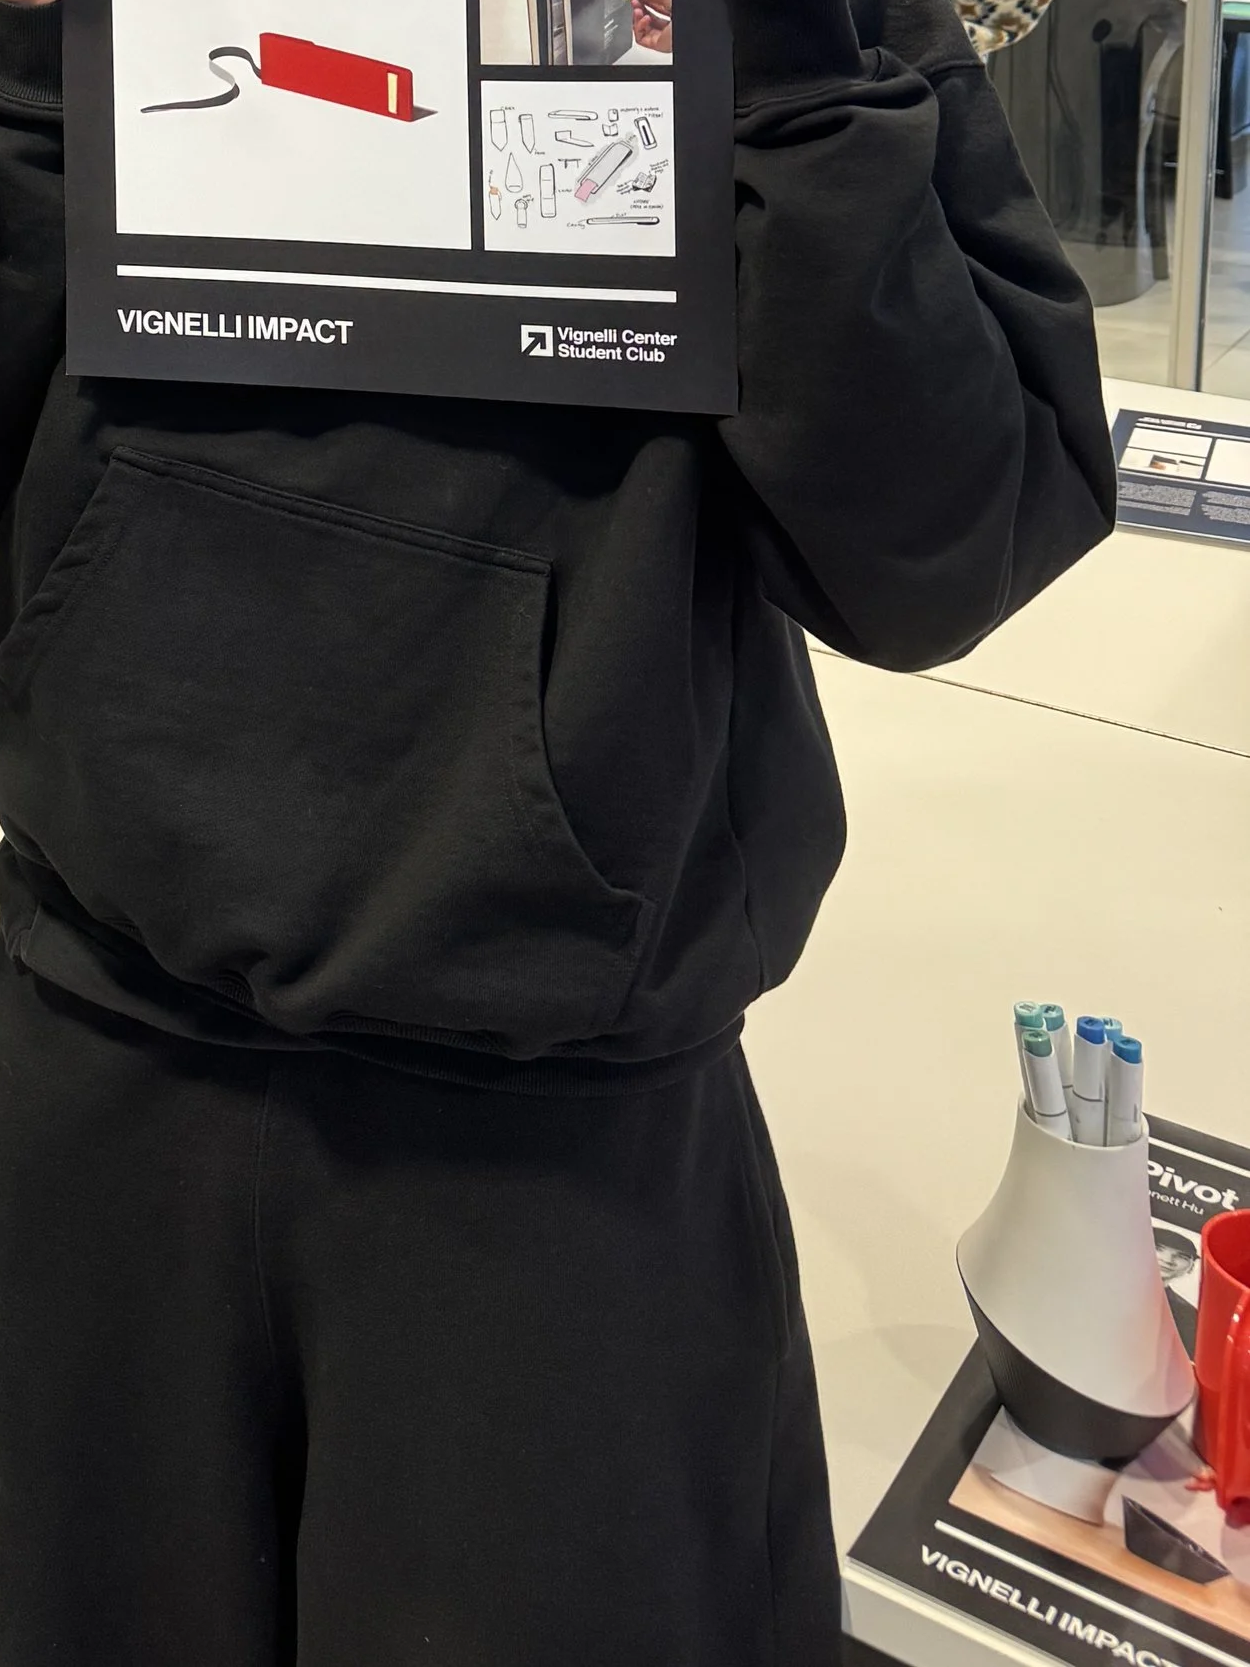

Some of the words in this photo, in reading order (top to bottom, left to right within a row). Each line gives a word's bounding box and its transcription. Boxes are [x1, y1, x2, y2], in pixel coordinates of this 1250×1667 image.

[117, 309, 242, 338] VIGNELLI
[248, 315, 354, 344] IMPACT
[557, 327, 617, 344] Vignelli
[622, 330, 677, 346] Center
[558, 344, 622, 360] Student
[626, 348, 665, 362] Club
[1182, 1201, 1205, 1215] Hu
[920, 1544, 1056, 1625] VIGNELLI
